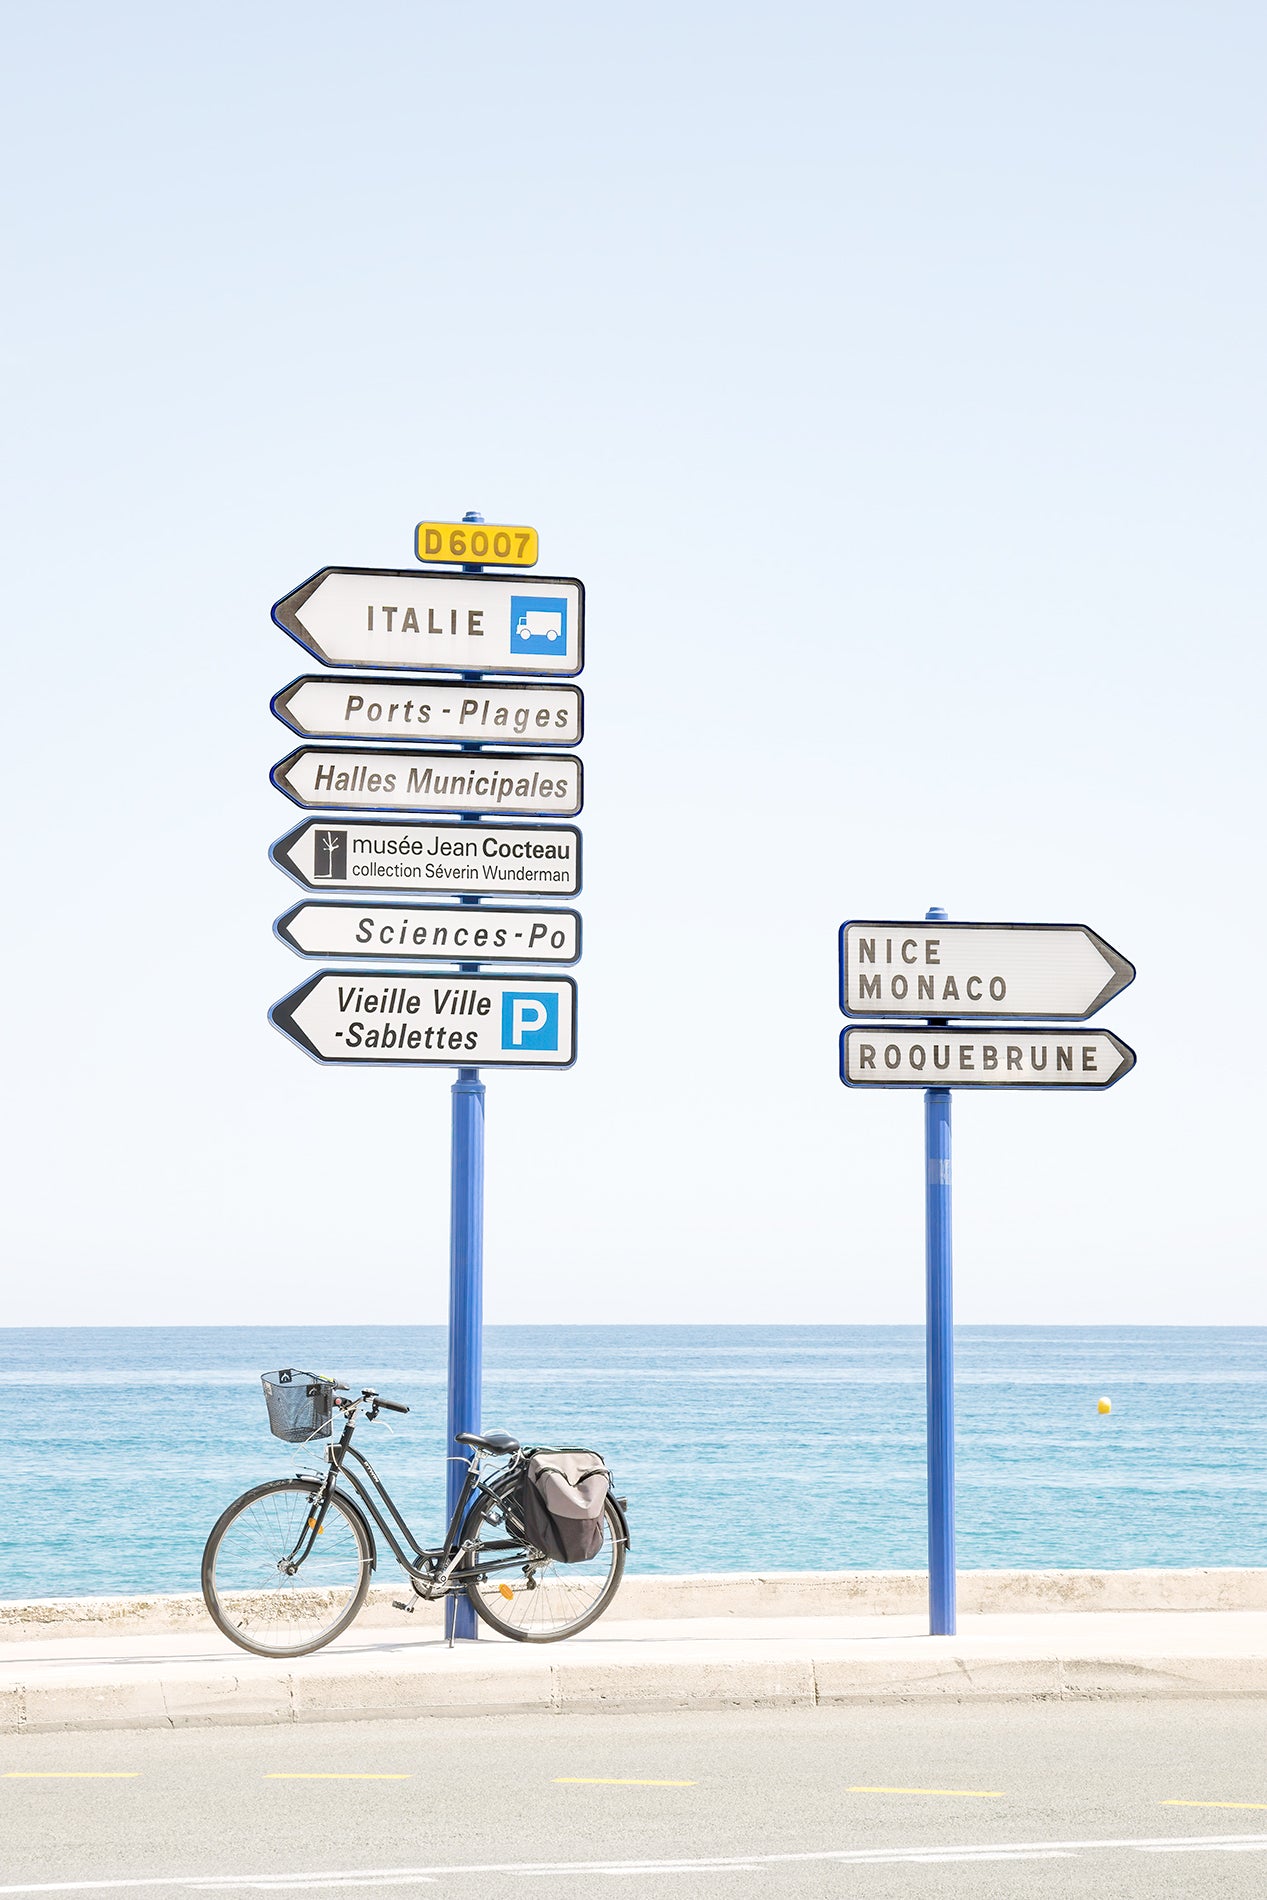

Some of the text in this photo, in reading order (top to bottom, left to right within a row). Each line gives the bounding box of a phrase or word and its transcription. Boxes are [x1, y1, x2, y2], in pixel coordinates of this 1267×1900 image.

[366, 604, 485, 636] ITALIE
[313, 764, 569, 803] Halles Municipales
[351, 834, 570, 860] musée Jean Cocteau
[351, 861, 570, 883] collection Séverin Wunderman
[355, 917, 566, 950] Sciences-Po
[858, 938, 941, 965] NICE
[337, 986, 492, 1016] Vieille Ville
[858, 973, 1007, 1001] MONACO
[334, 1021, 479, 1050] -Sablettes
[512, 998, 548, 1045] P
[859, 1043, 1098, 1072] ROQUEBRUNE
